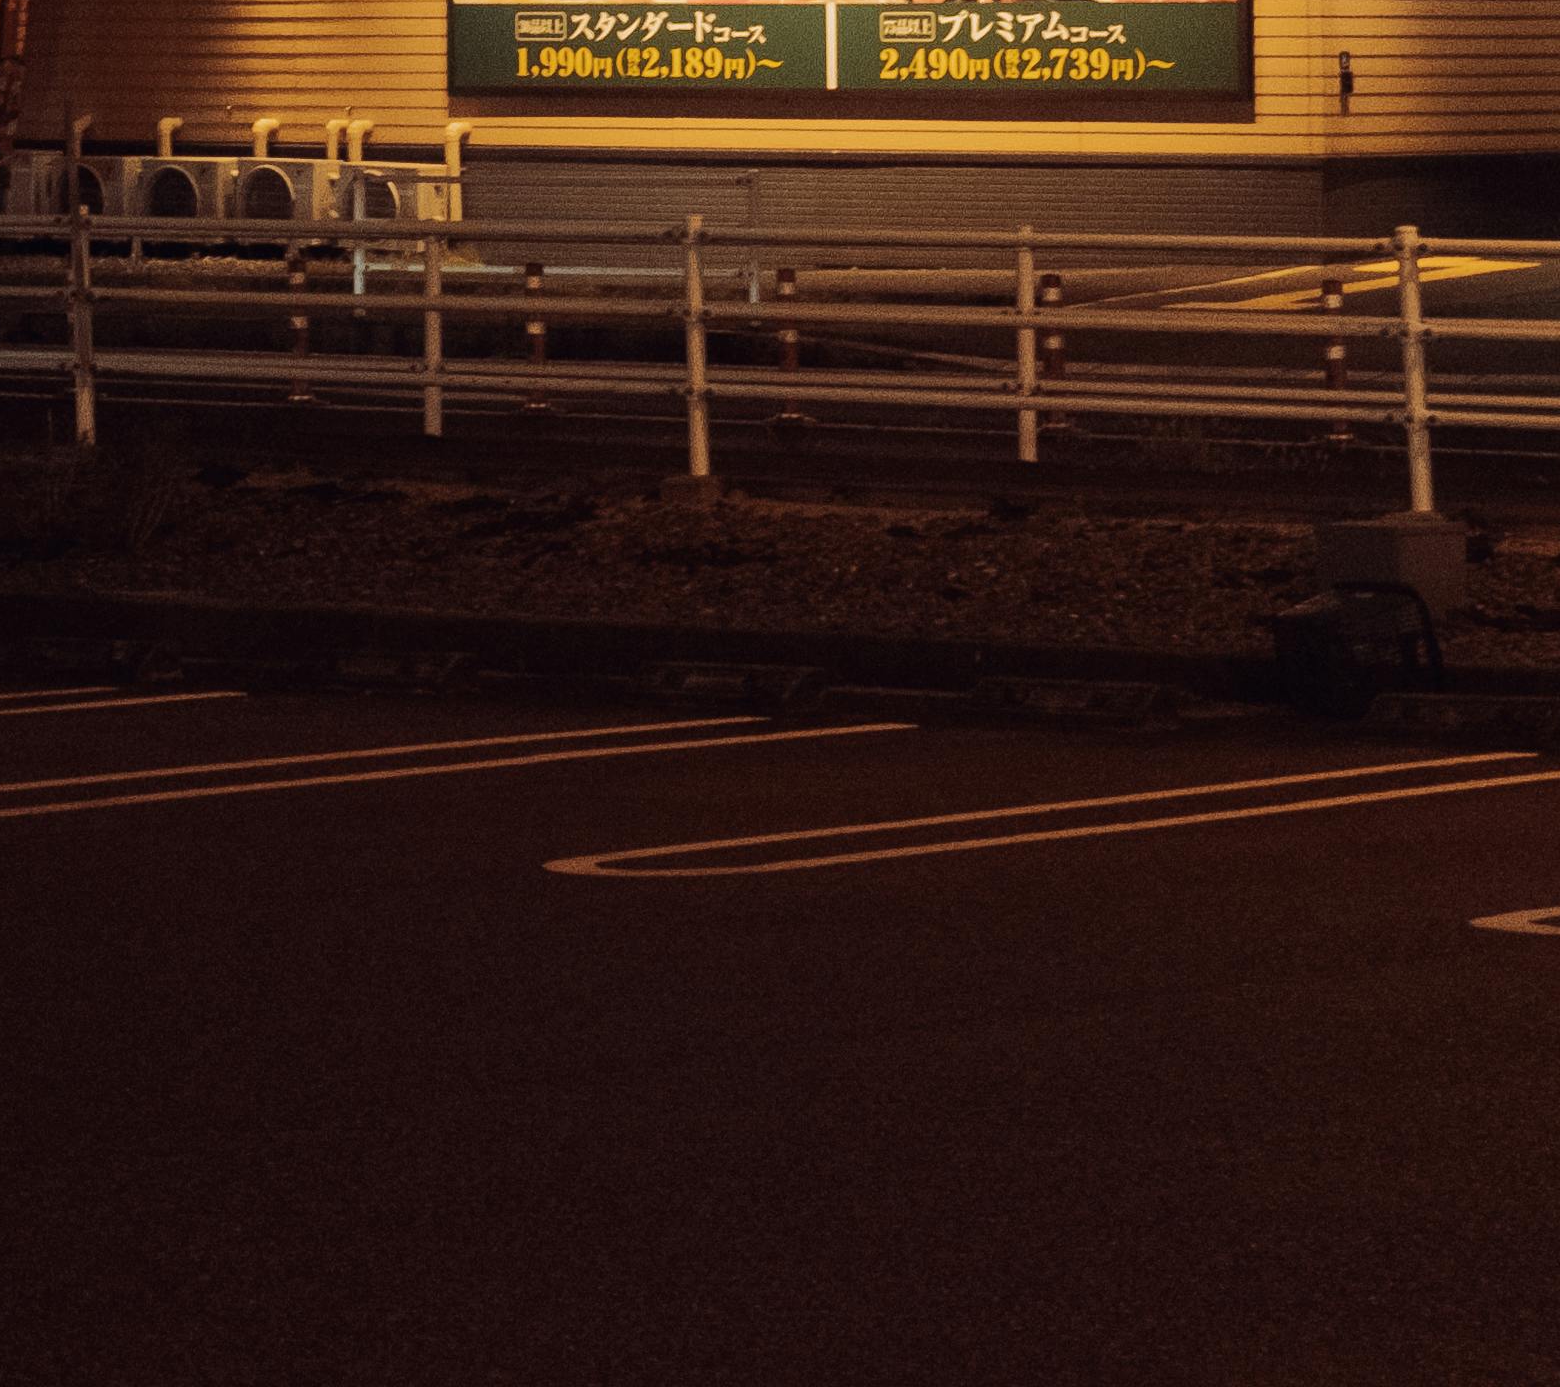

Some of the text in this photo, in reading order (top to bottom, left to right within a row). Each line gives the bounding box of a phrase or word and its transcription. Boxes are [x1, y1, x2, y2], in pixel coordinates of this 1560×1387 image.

[568, 10, 767, 44] スタンダードコース
[937, 10, 1127, 45] プレミアムコース
